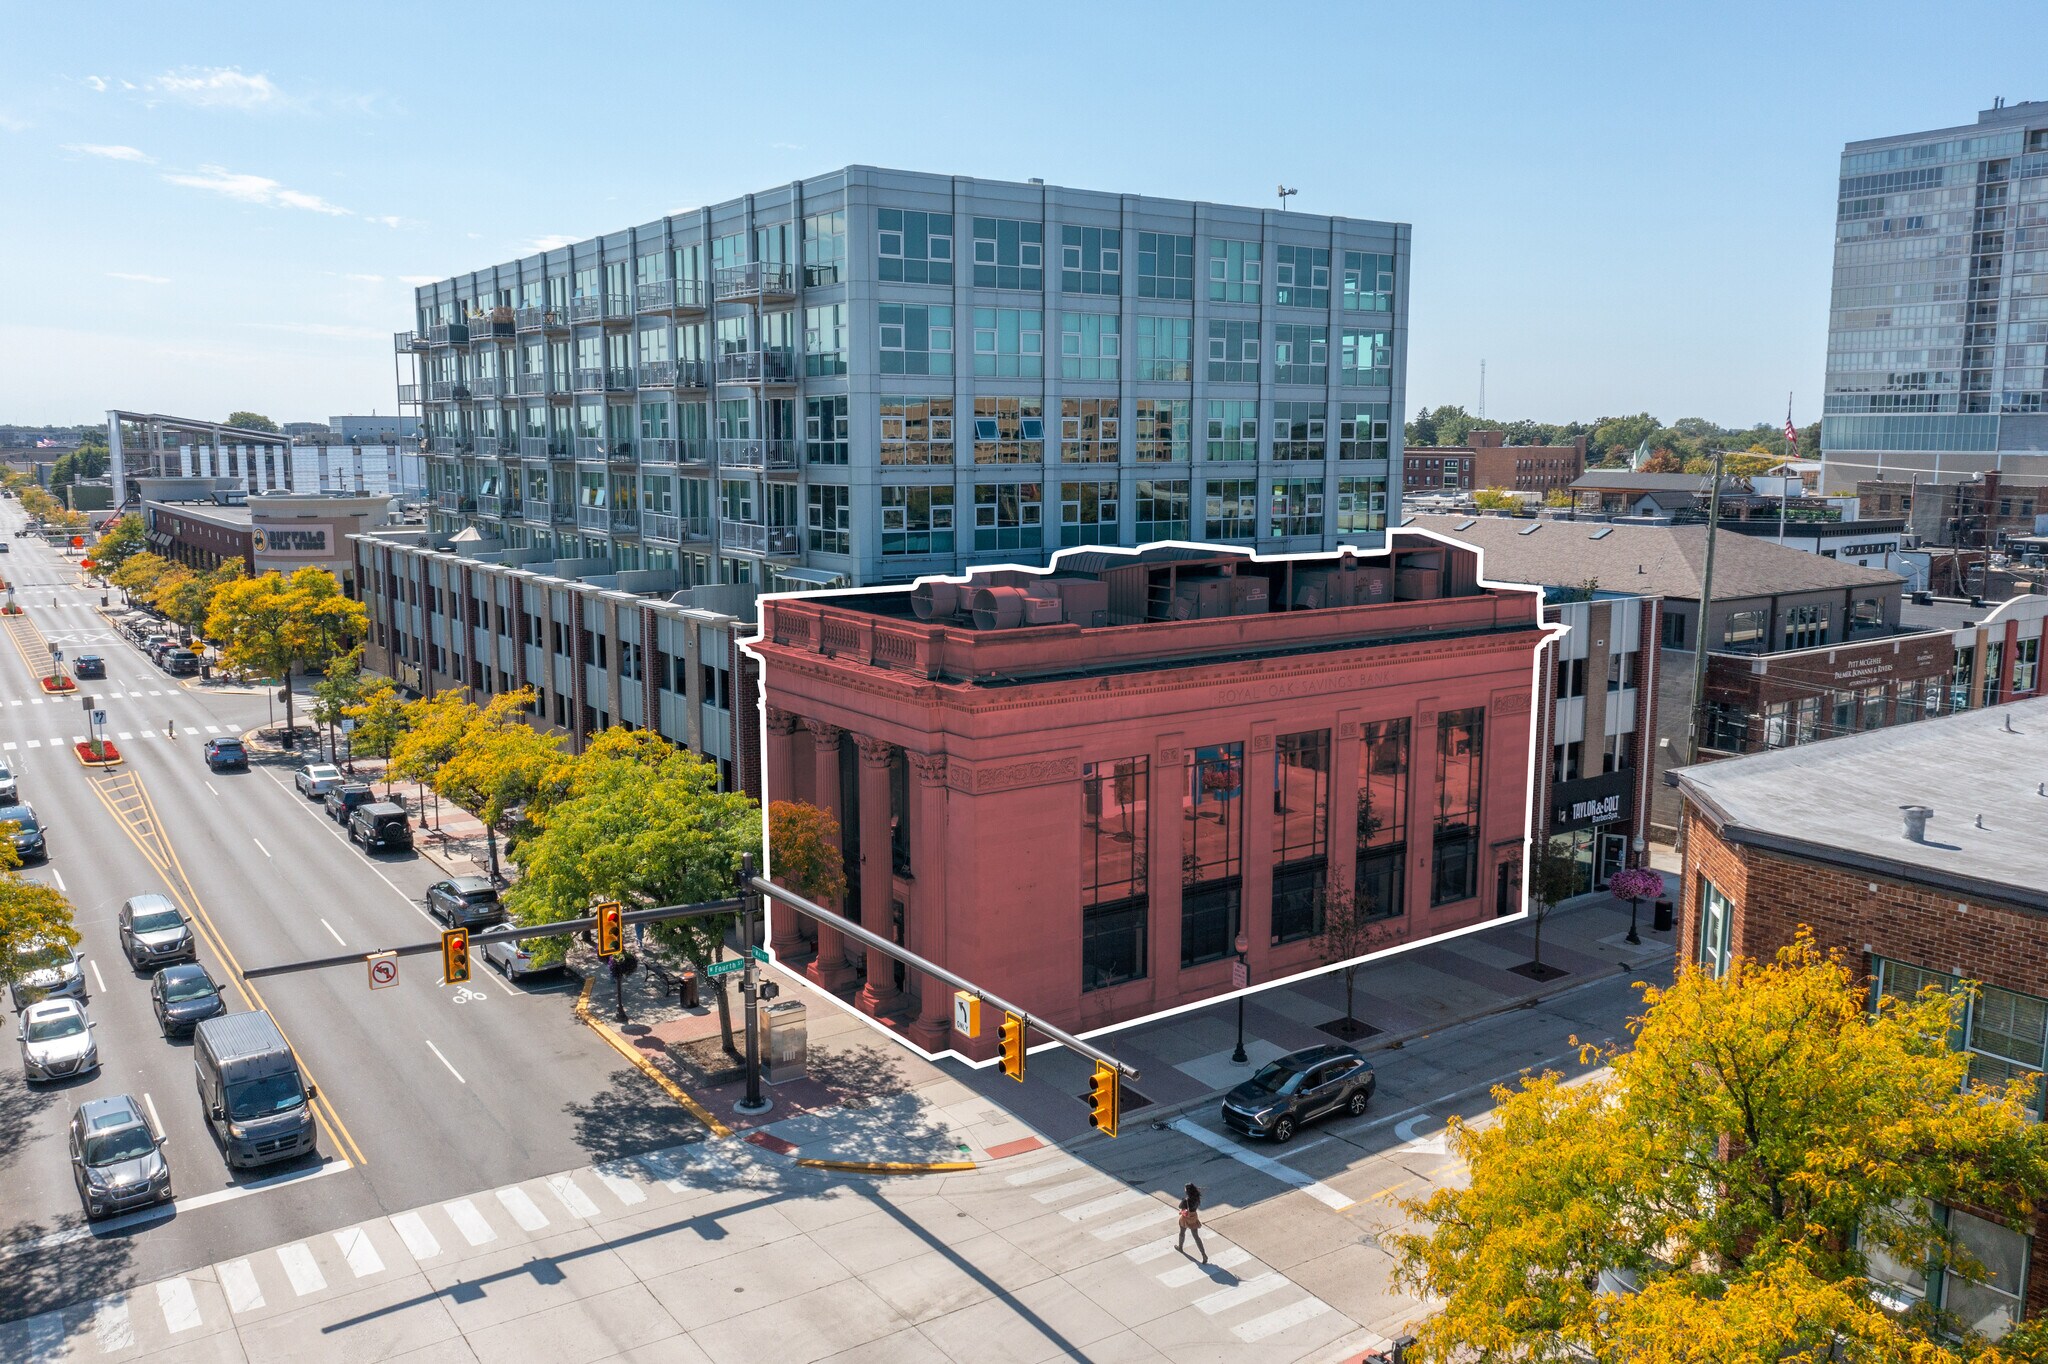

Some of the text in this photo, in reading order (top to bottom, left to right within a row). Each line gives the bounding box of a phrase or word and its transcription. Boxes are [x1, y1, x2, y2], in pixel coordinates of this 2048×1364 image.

[269, 531, 325, 542] BUFFALO
[271, 542, 326, 550] WILD WINGS
[1218, 670, 1390, 703] ROYAL OAK SAVINGS BANK
[714, 963, 737, 973] Fourth
[957, 1020, 968, 1032] ONLY
